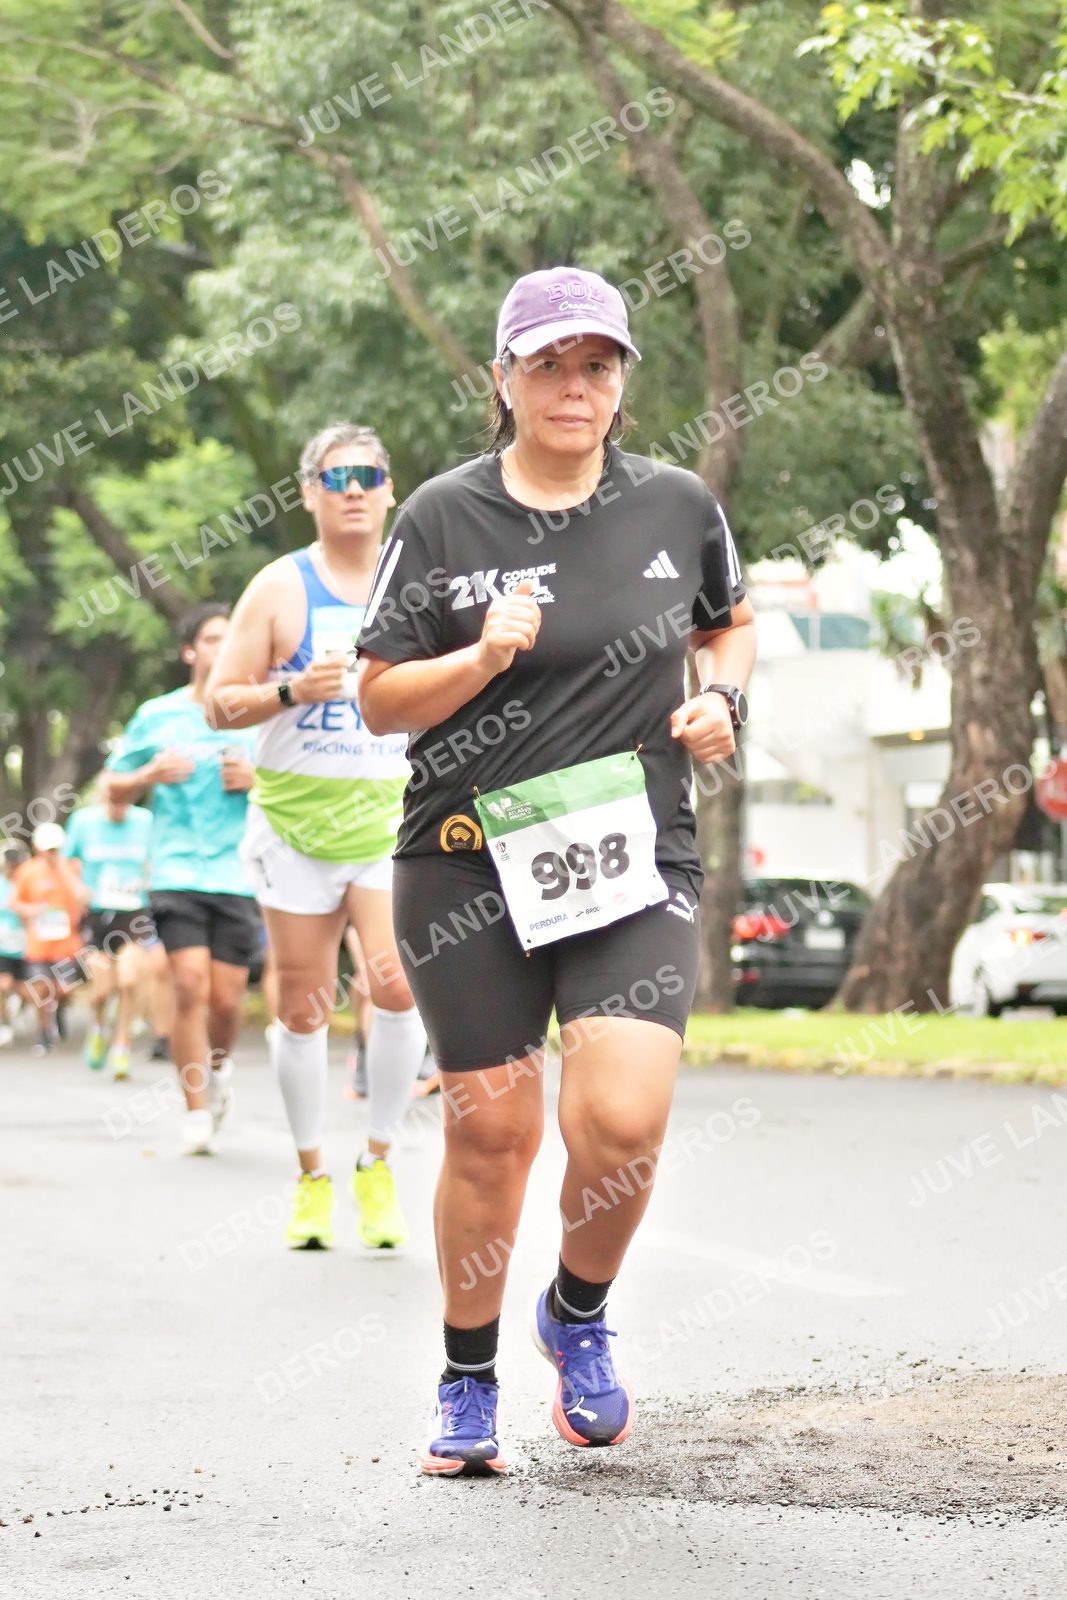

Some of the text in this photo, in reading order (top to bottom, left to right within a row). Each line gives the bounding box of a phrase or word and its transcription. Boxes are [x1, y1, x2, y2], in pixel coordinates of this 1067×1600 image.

[545, 281, 605, 304] BOL
[501, 563, 557, 583] COMUDE
[449, 568, 505, 611] 21K
[531, 832, 630, 901] 998
[529, 913, 569, 931] PERDURA
